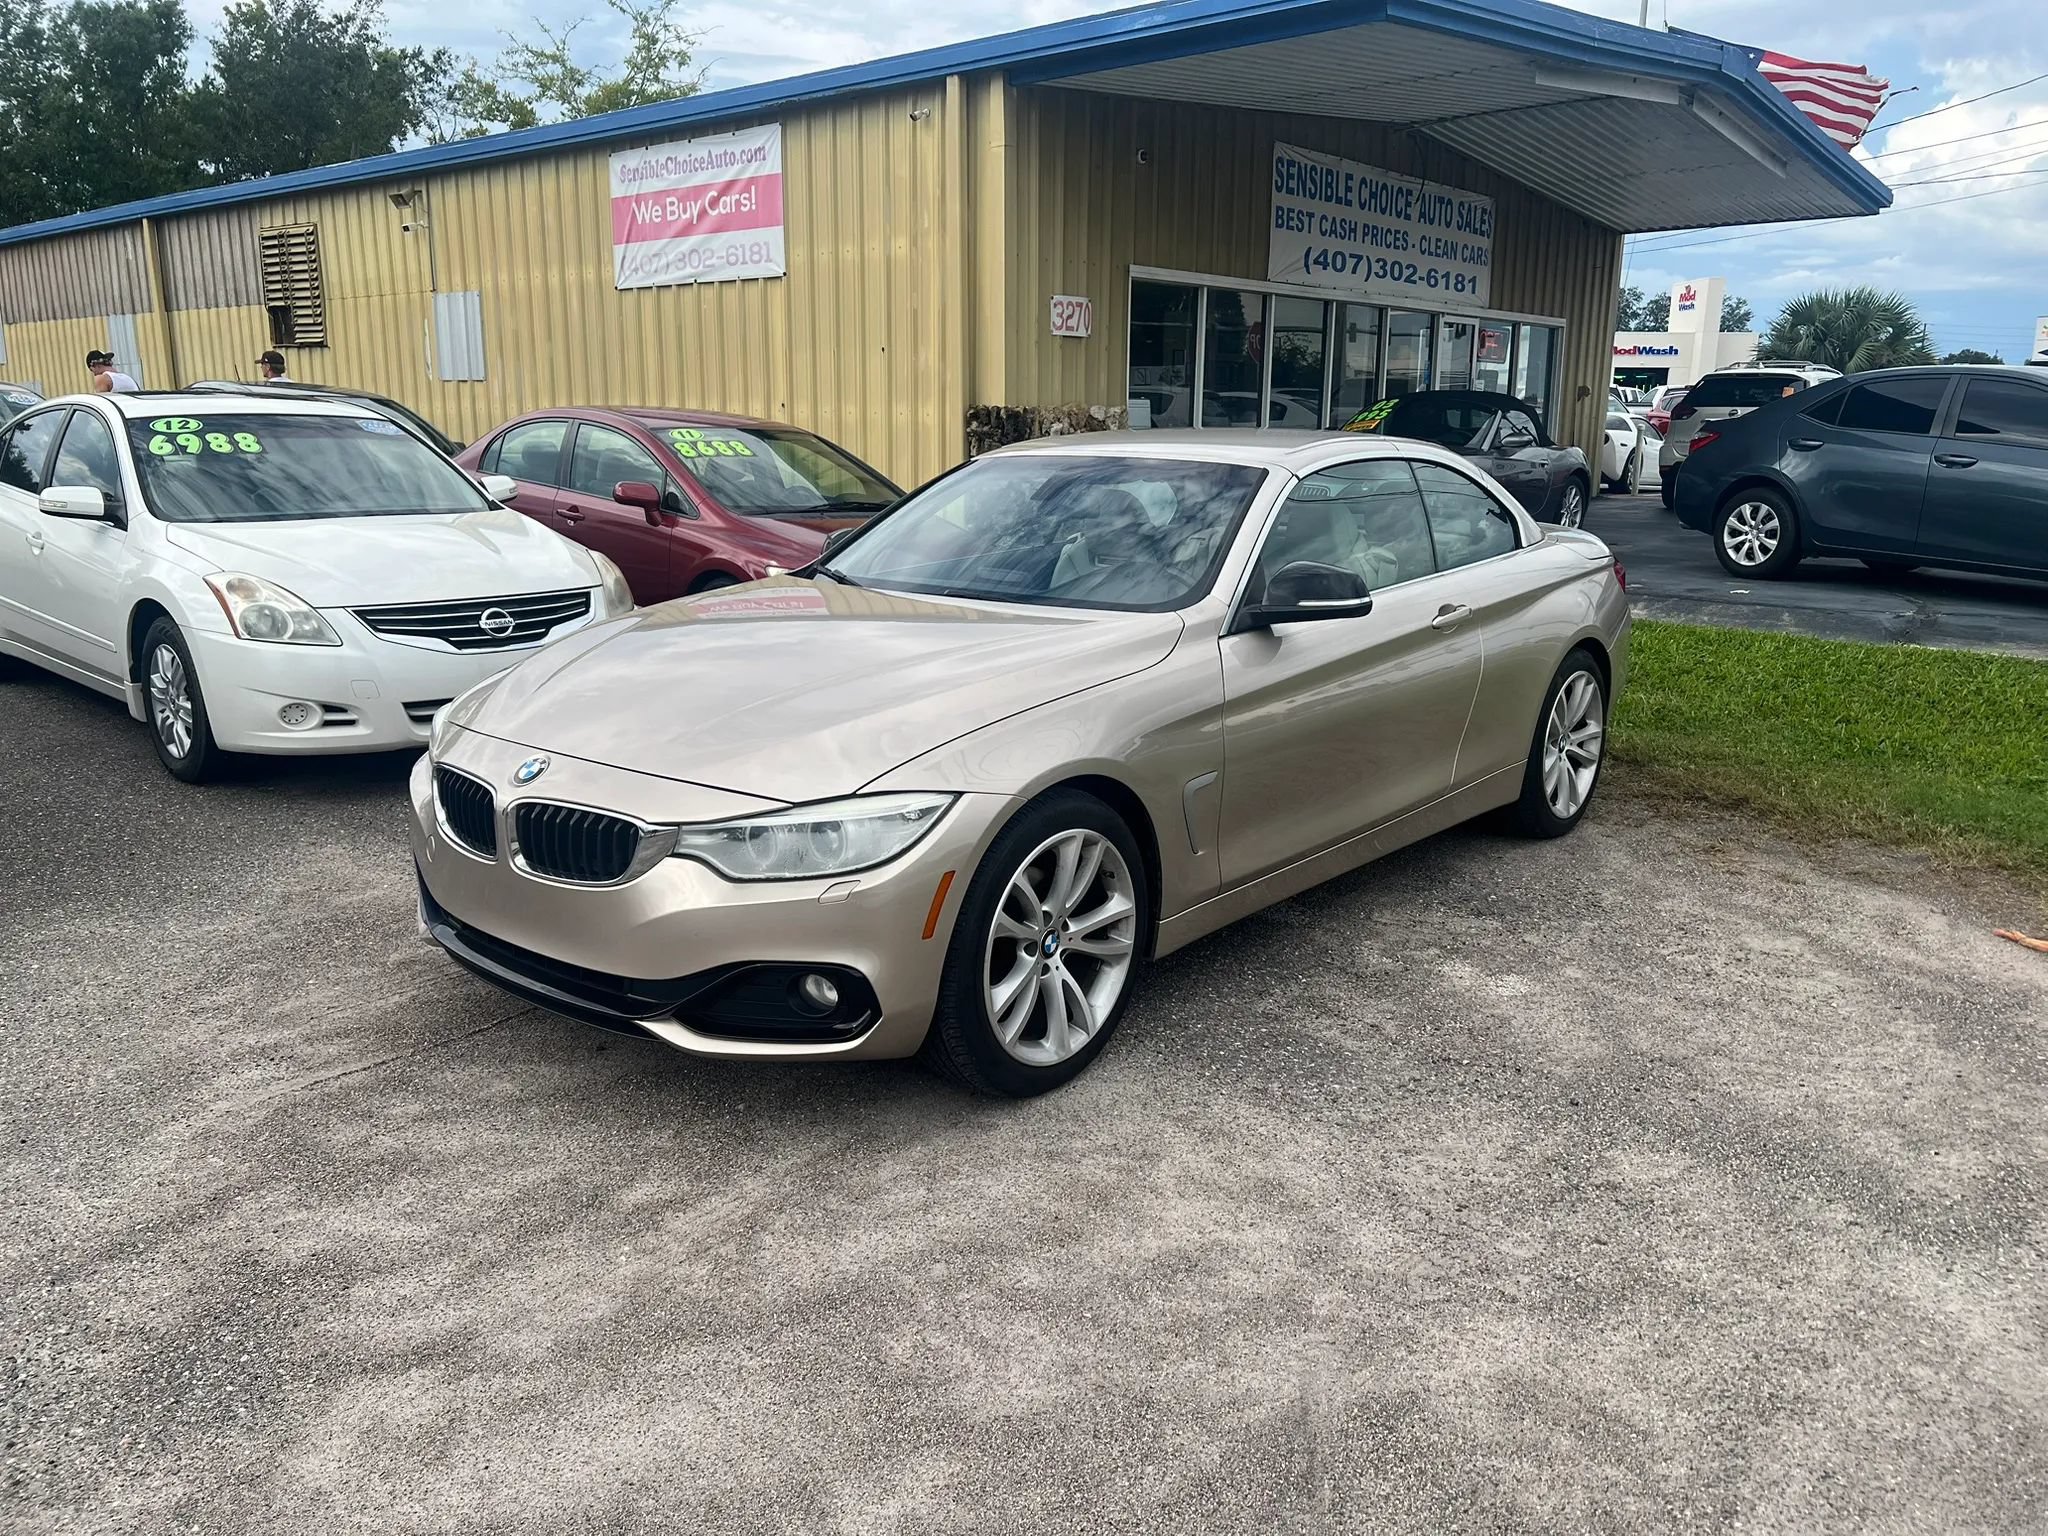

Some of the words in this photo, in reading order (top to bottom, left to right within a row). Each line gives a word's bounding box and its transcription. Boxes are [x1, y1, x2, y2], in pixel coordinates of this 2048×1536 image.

[619, 145, 767, 183] SensibleChoiceAuto.com
[632, 200, 662, 225] We
[666, 196, 702, 225] Buy
[704, 185, 756, 216] Cars!
[1274, 156, 1354, 207] SENSIBLE
[1357, 176, 1413, 221] CHOICE
[1417, 193, 1454, 229] AUTO
[1456, 200, 1493, 240] SALES
[1274, 205, 1315, 234] BEST
[1319, 214, 1358, 242] CASH
[1362, 223, 1409, 251] PRICES
[1419, 235, 1458, 261] CLEAN
[1461, 243, 1489, 267] CARS
[1303, 246, 1478, 294] (407)302-6181
[1052, 300, 1091, 334] 3270
[1678, 303, 1695, 311] Wash
[162, 420, 191, 430] 12
[677, 430, 695, 439] 11
[148, 432, 263, 456] 6988
[673, 440, 754, 458] 8688
[484, 619, 513, 627] NISSAN
